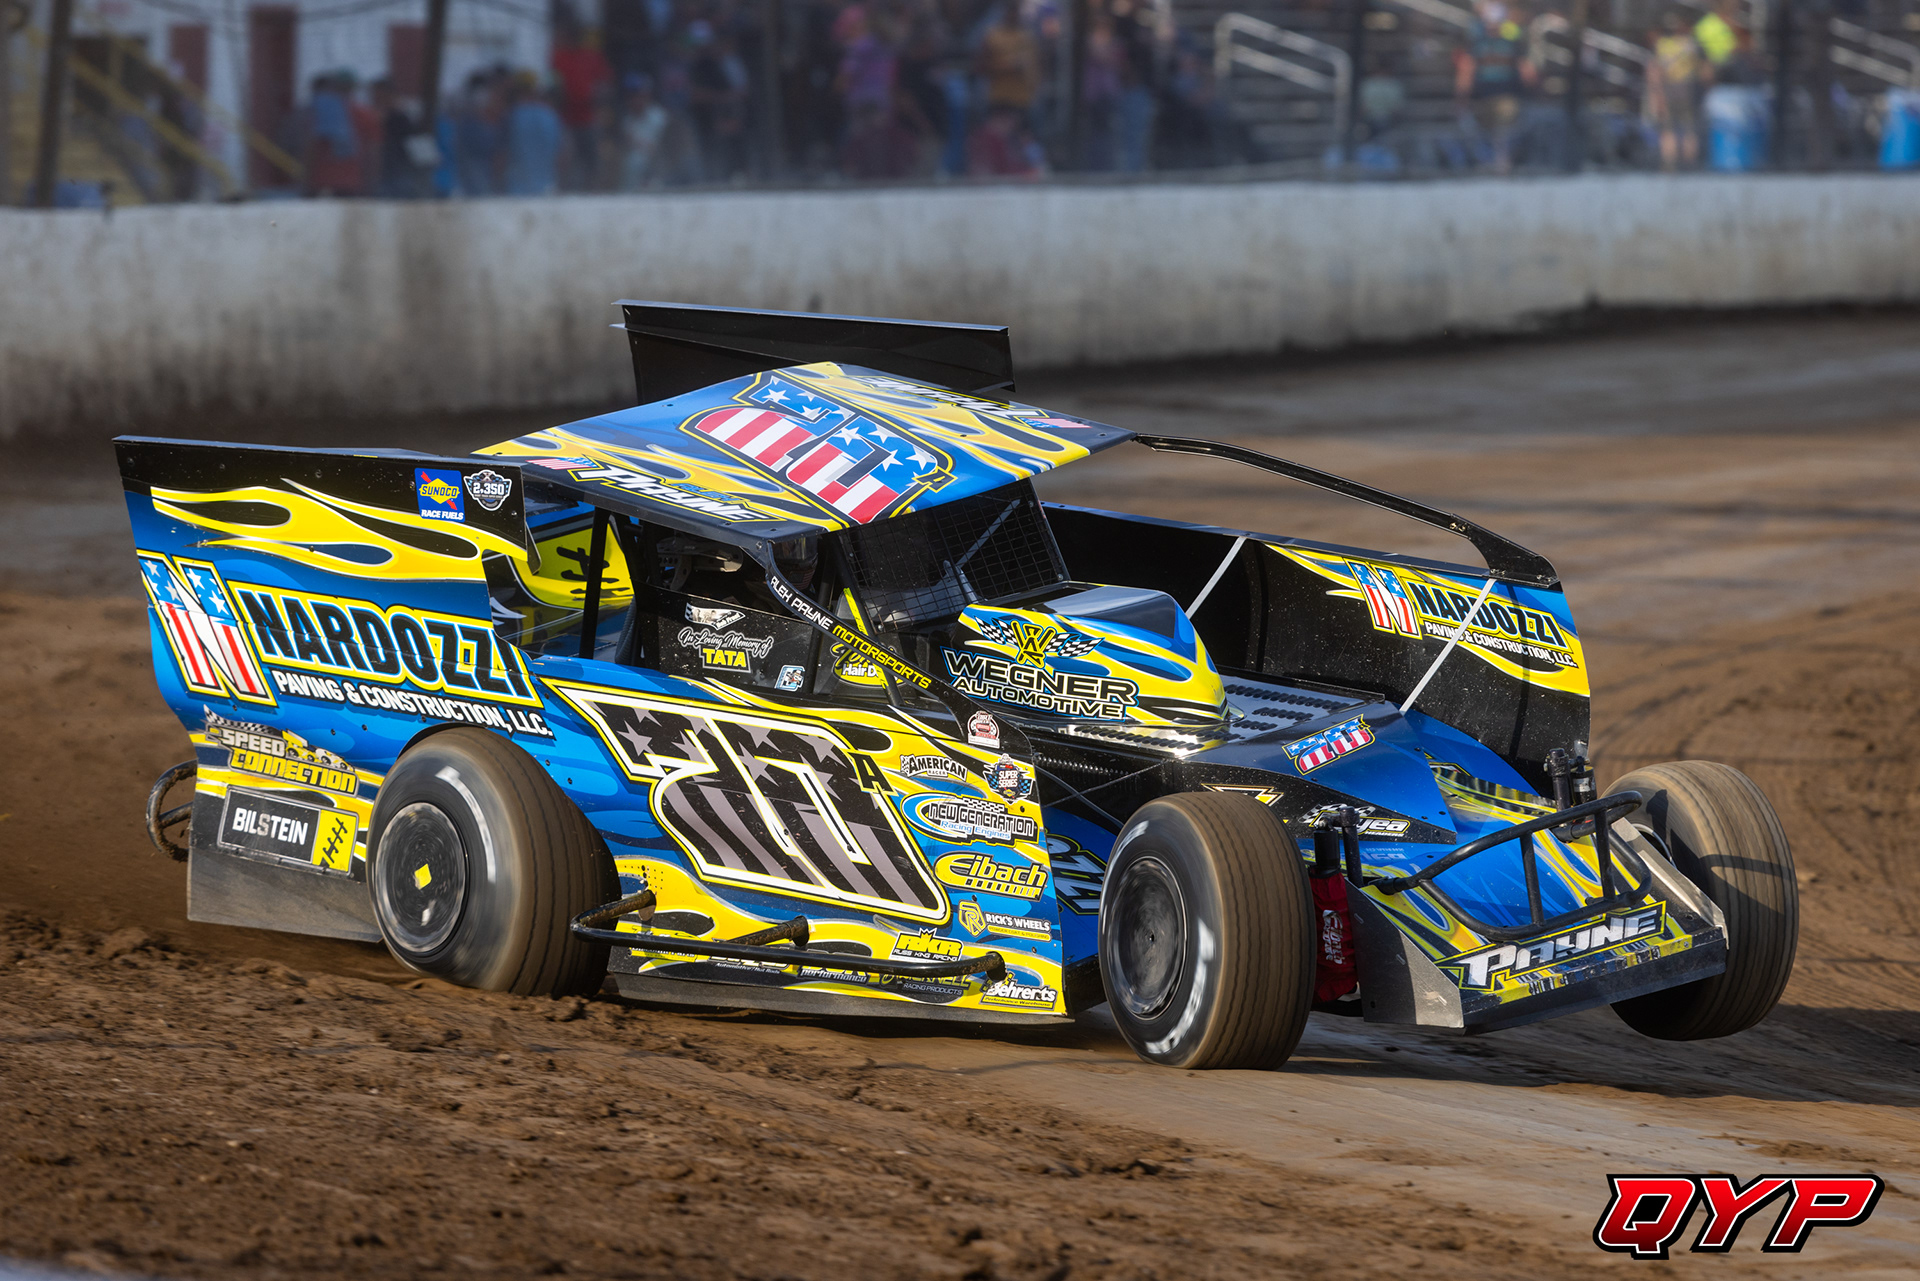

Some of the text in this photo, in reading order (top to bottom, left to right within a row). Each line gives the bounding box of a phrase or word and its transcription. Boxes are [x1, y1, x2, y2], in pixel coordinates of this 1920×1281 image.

[421, 485, 458, 497] SUNOCO
[472, 482, 505, 495] 2,350
[421, 509, 464, 520] RACE FUELS
[1406, 580, 1569, 650] NARDOZZI
[236, 588, 535, 700] NARDOZZI
[694, 631, 723, 650] Loving
[723, 632, 761, 655] Memory
[760, 638, 772, 656] of
[770, 575, 792, 602] ALEX
[790, 597, 834, 631] PAYNE
[832, 624, 932, 690] MOTORSPORTS
[702, 647, 747, 668] TATA
[1464, 630, 1475, 643] &
[1553, 651, 1579, 668] LLC.
[842, 663, 867, 677] Hair
[944, 648, 1138, 706] WEGNER
[272, 669, 555, 738] PAVING & CONSTRUCTION, LLC.
[952, 676, 1123, 720] AUTOMOTIVE
[220, 729, 286, 758] SPEED
[230, 748, 357, 794] CONNECTION
[908, 756, 966, 780] AMERICAN
[998, 770, 1018, 779] SUPER
[998, 778, 1018, 788] SERIES
[232, 806, 309, 846] BILSTEIN
[929, 803, 1034, 837] NEW GENERATION
[940, 820, 1010, 840] Racing Engines
[934, 852, 1047, 888] Eibach
[985, 912, 1051, 932] RICK'S WHEELS
[893, 949, 958, 962] RUSS KING RACING
[1456, 909, 1658, 986] PAYNE
[800, 969, 868, 983] performance
[903, 983, 963, 996] RACING PRODUCTS
